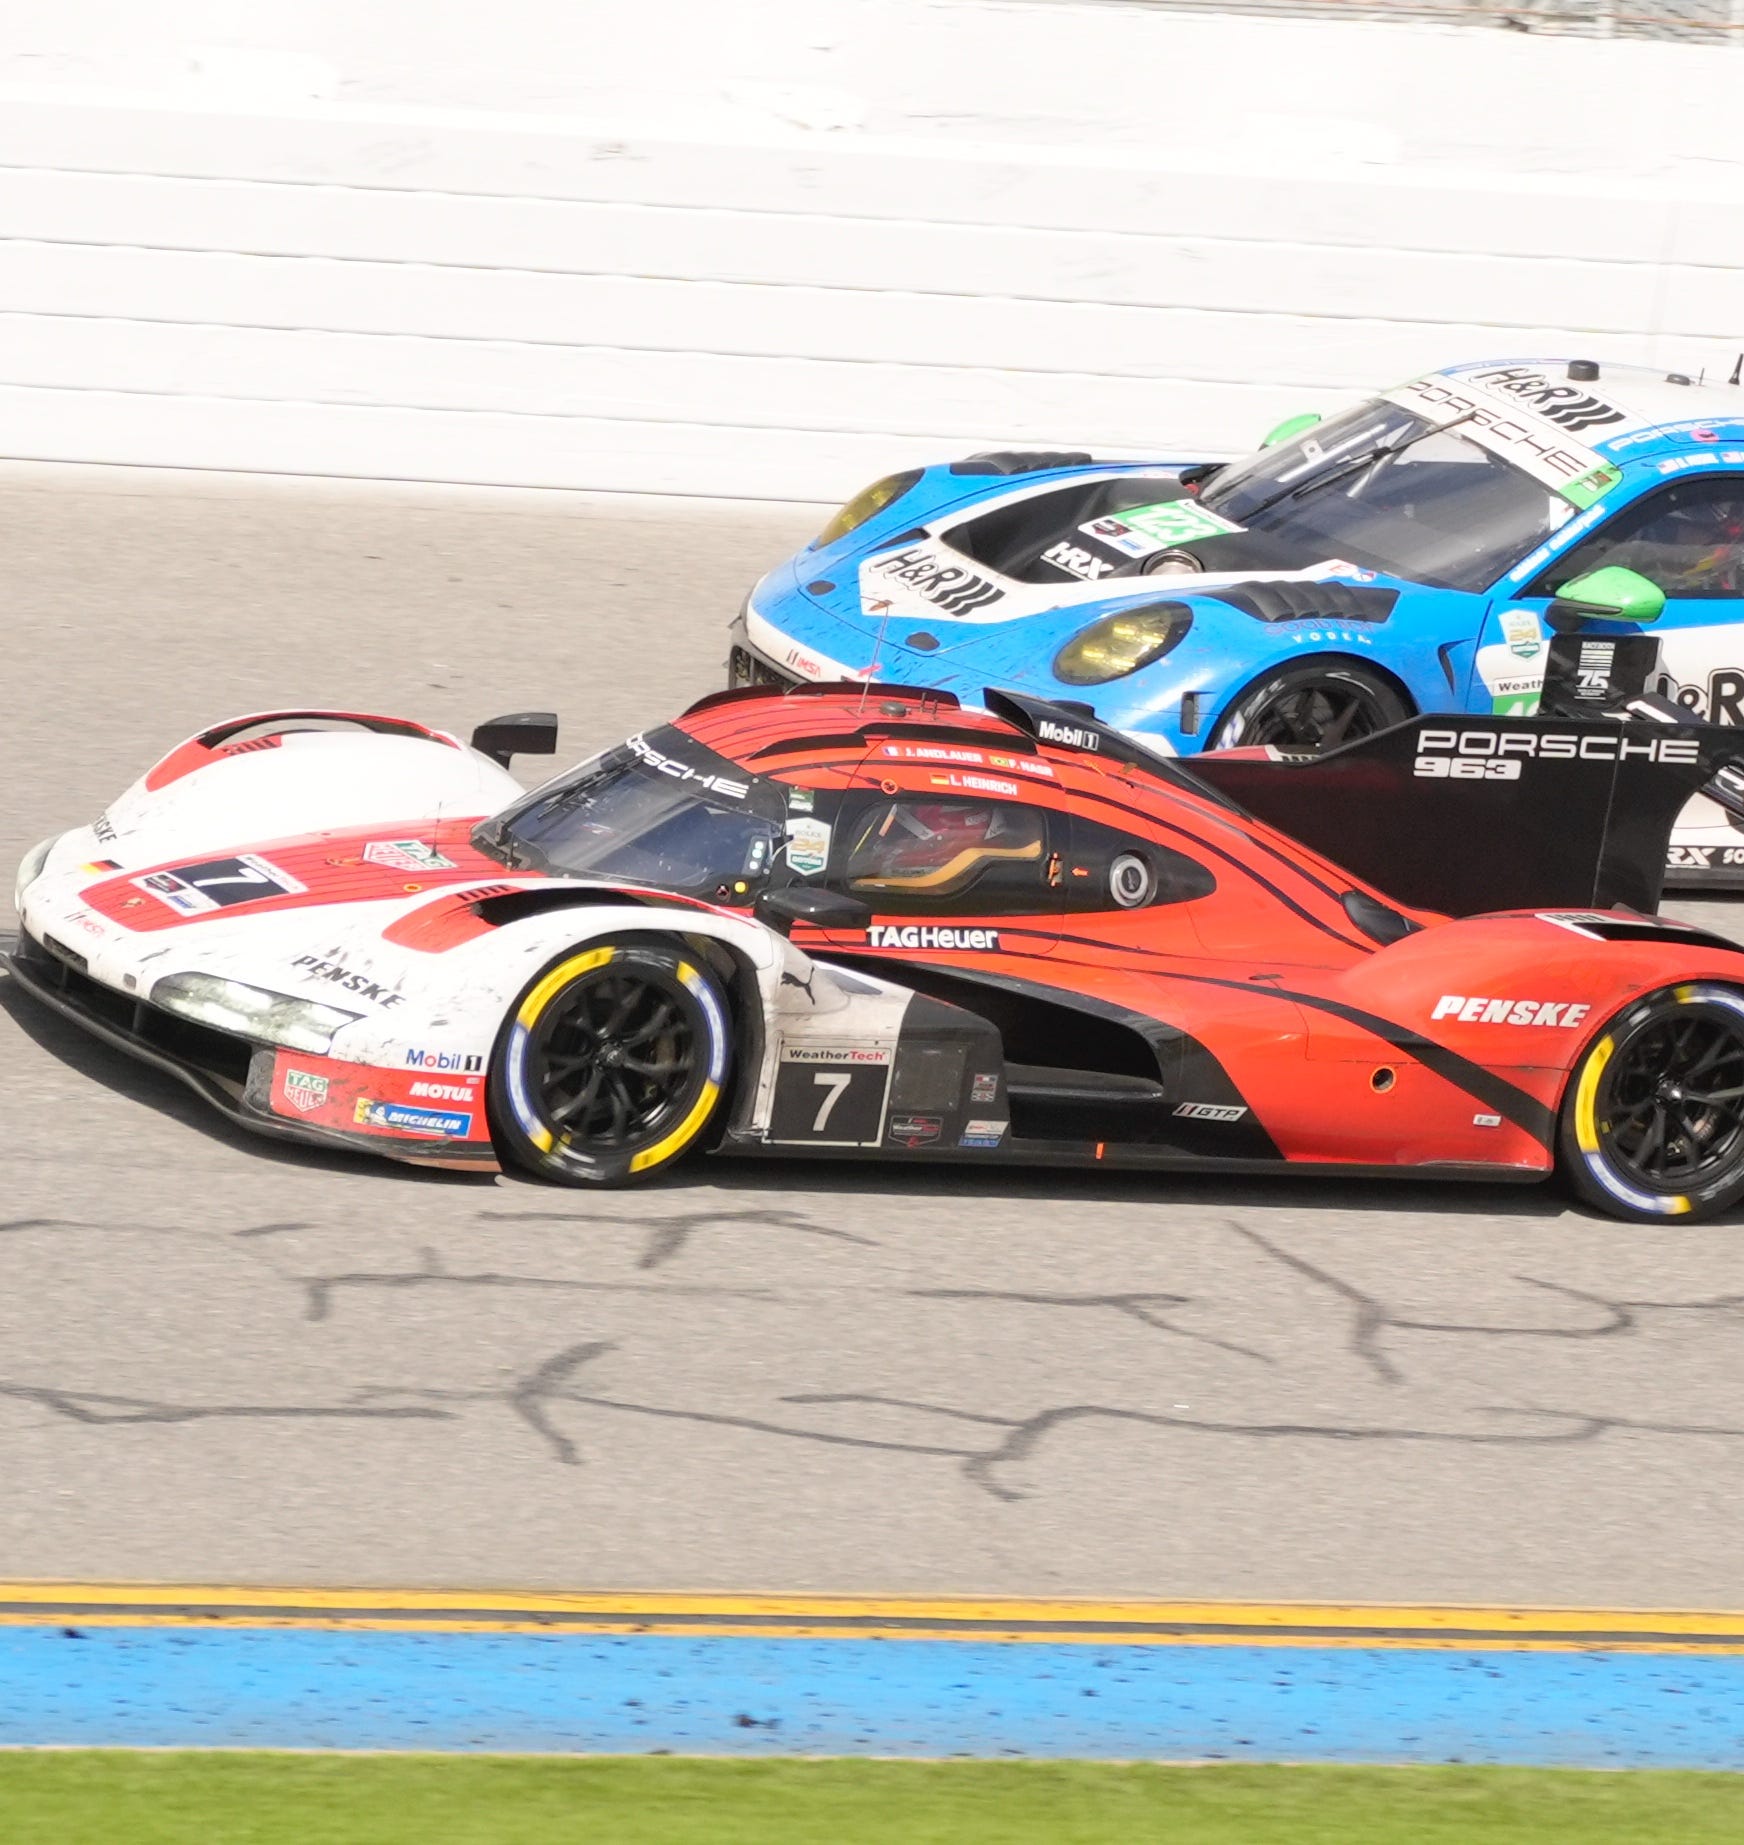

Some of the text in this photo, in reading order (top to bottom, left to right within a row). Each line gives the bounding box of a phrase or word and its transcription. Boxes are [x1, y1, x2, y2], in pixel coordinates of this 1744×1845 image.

[1472, 367, 1579, 404] H&R
[1405, 380, 1588, 477] PORSCHE
[870, 549, 965, 593] H&R
[1042, 541, 1114, 580] HRX
[1500, 679, 1543, 692] Weath
[1577, 669, 1611, 690] 75
[1039, 721, 1082, 748] Mobil
[1417, 730, 1700, 764] PORSCHE
[626, 730, 750, 799] ORSCHE
[1413, 756, 1522, 780] 963
[962, 775, 1018, 796] HEINRICH
[1666, 847, 1717, 865] RX
[192, 867, 269, 888] 7
[291, 955, 406, 1009] PENSKE
[1430, 995, 1591, 1028] PENSKE
[406, 1049, 462, 1070] Mobil
[789, 1050, 885, 1061] WeatherTech
[290, 1071, 324, 1091] TAG
[410, 1082, 474, 1102] MOTUL
[812, 1072, 852, 1132] 7
[1196, 1107, 1240, 1118] GTP
[388, 1111, 462, 1130] MICHELIN
